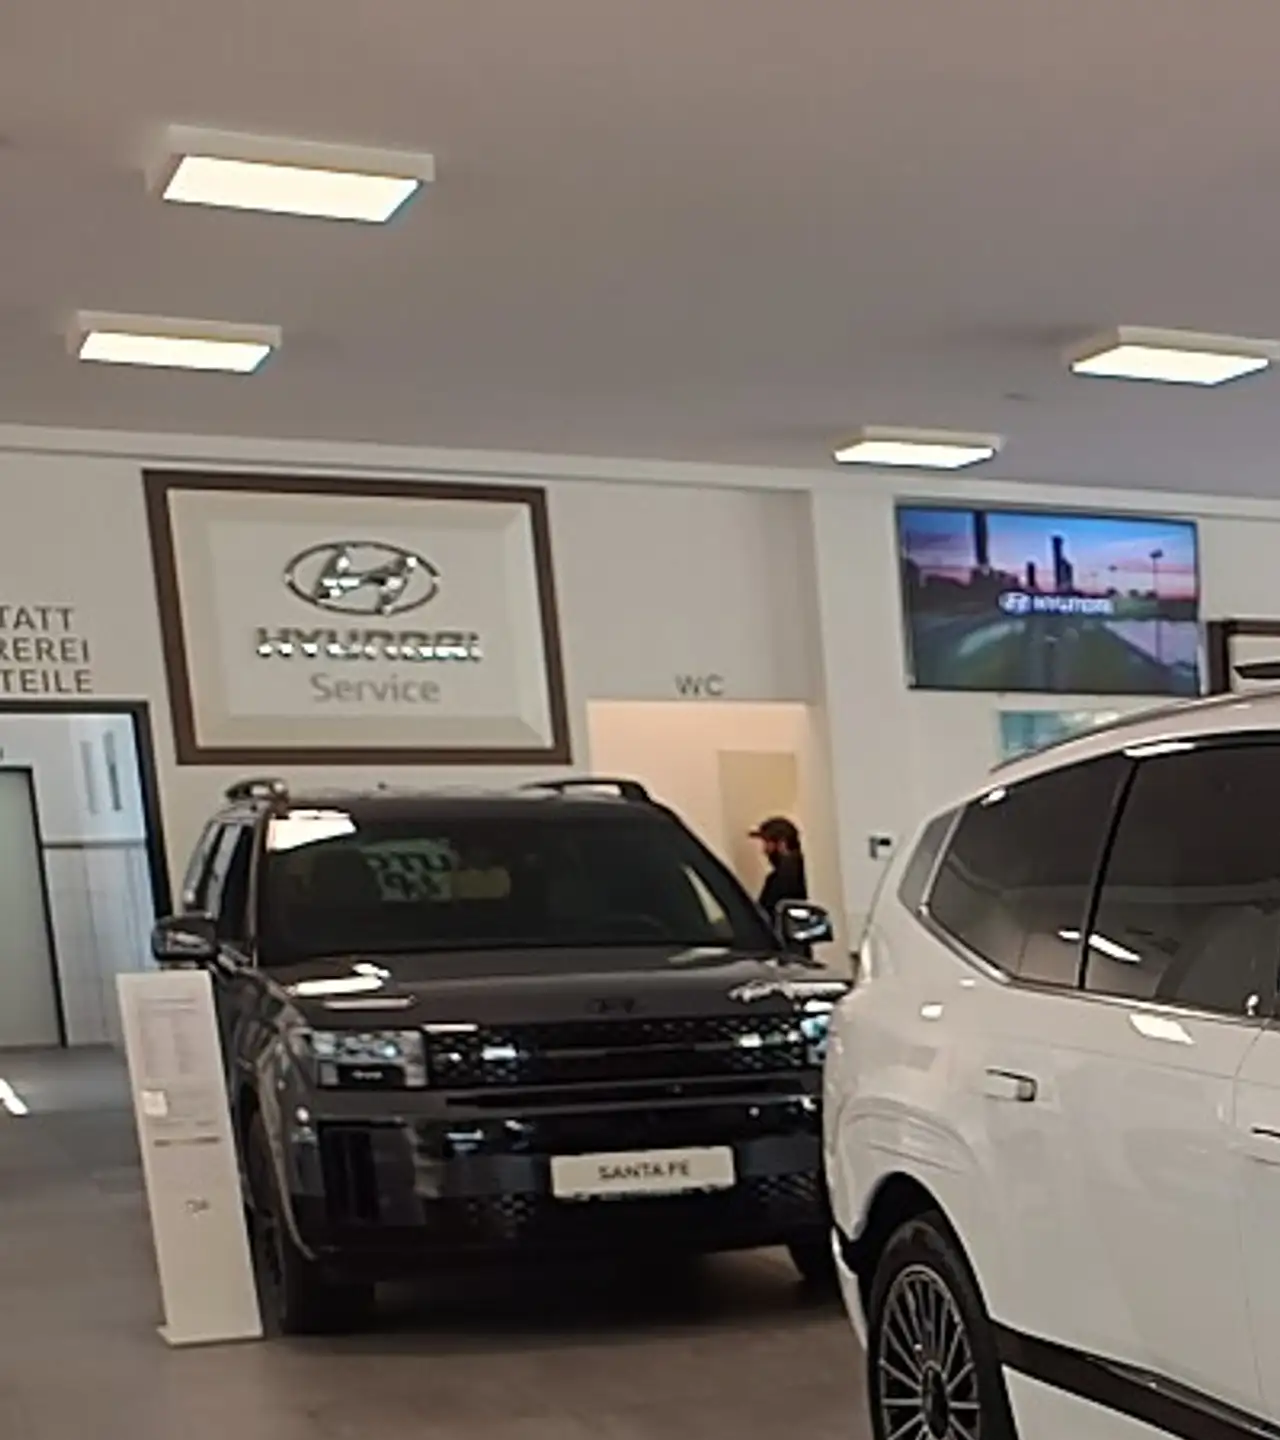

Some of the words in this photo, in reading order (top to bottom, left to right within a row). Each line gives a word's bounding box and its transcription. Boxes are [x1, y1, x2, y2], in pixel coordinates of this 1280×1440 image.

[256, 627, 483, 662] HYUNDAI
[0, 670, 94, 693] TEILE
[310, 673, 440, 702] Service
[675, 672, 725, 696] WC
[597, 1162, 664, 1180] SANTA
[668, 1159, 690, 1177] FE
